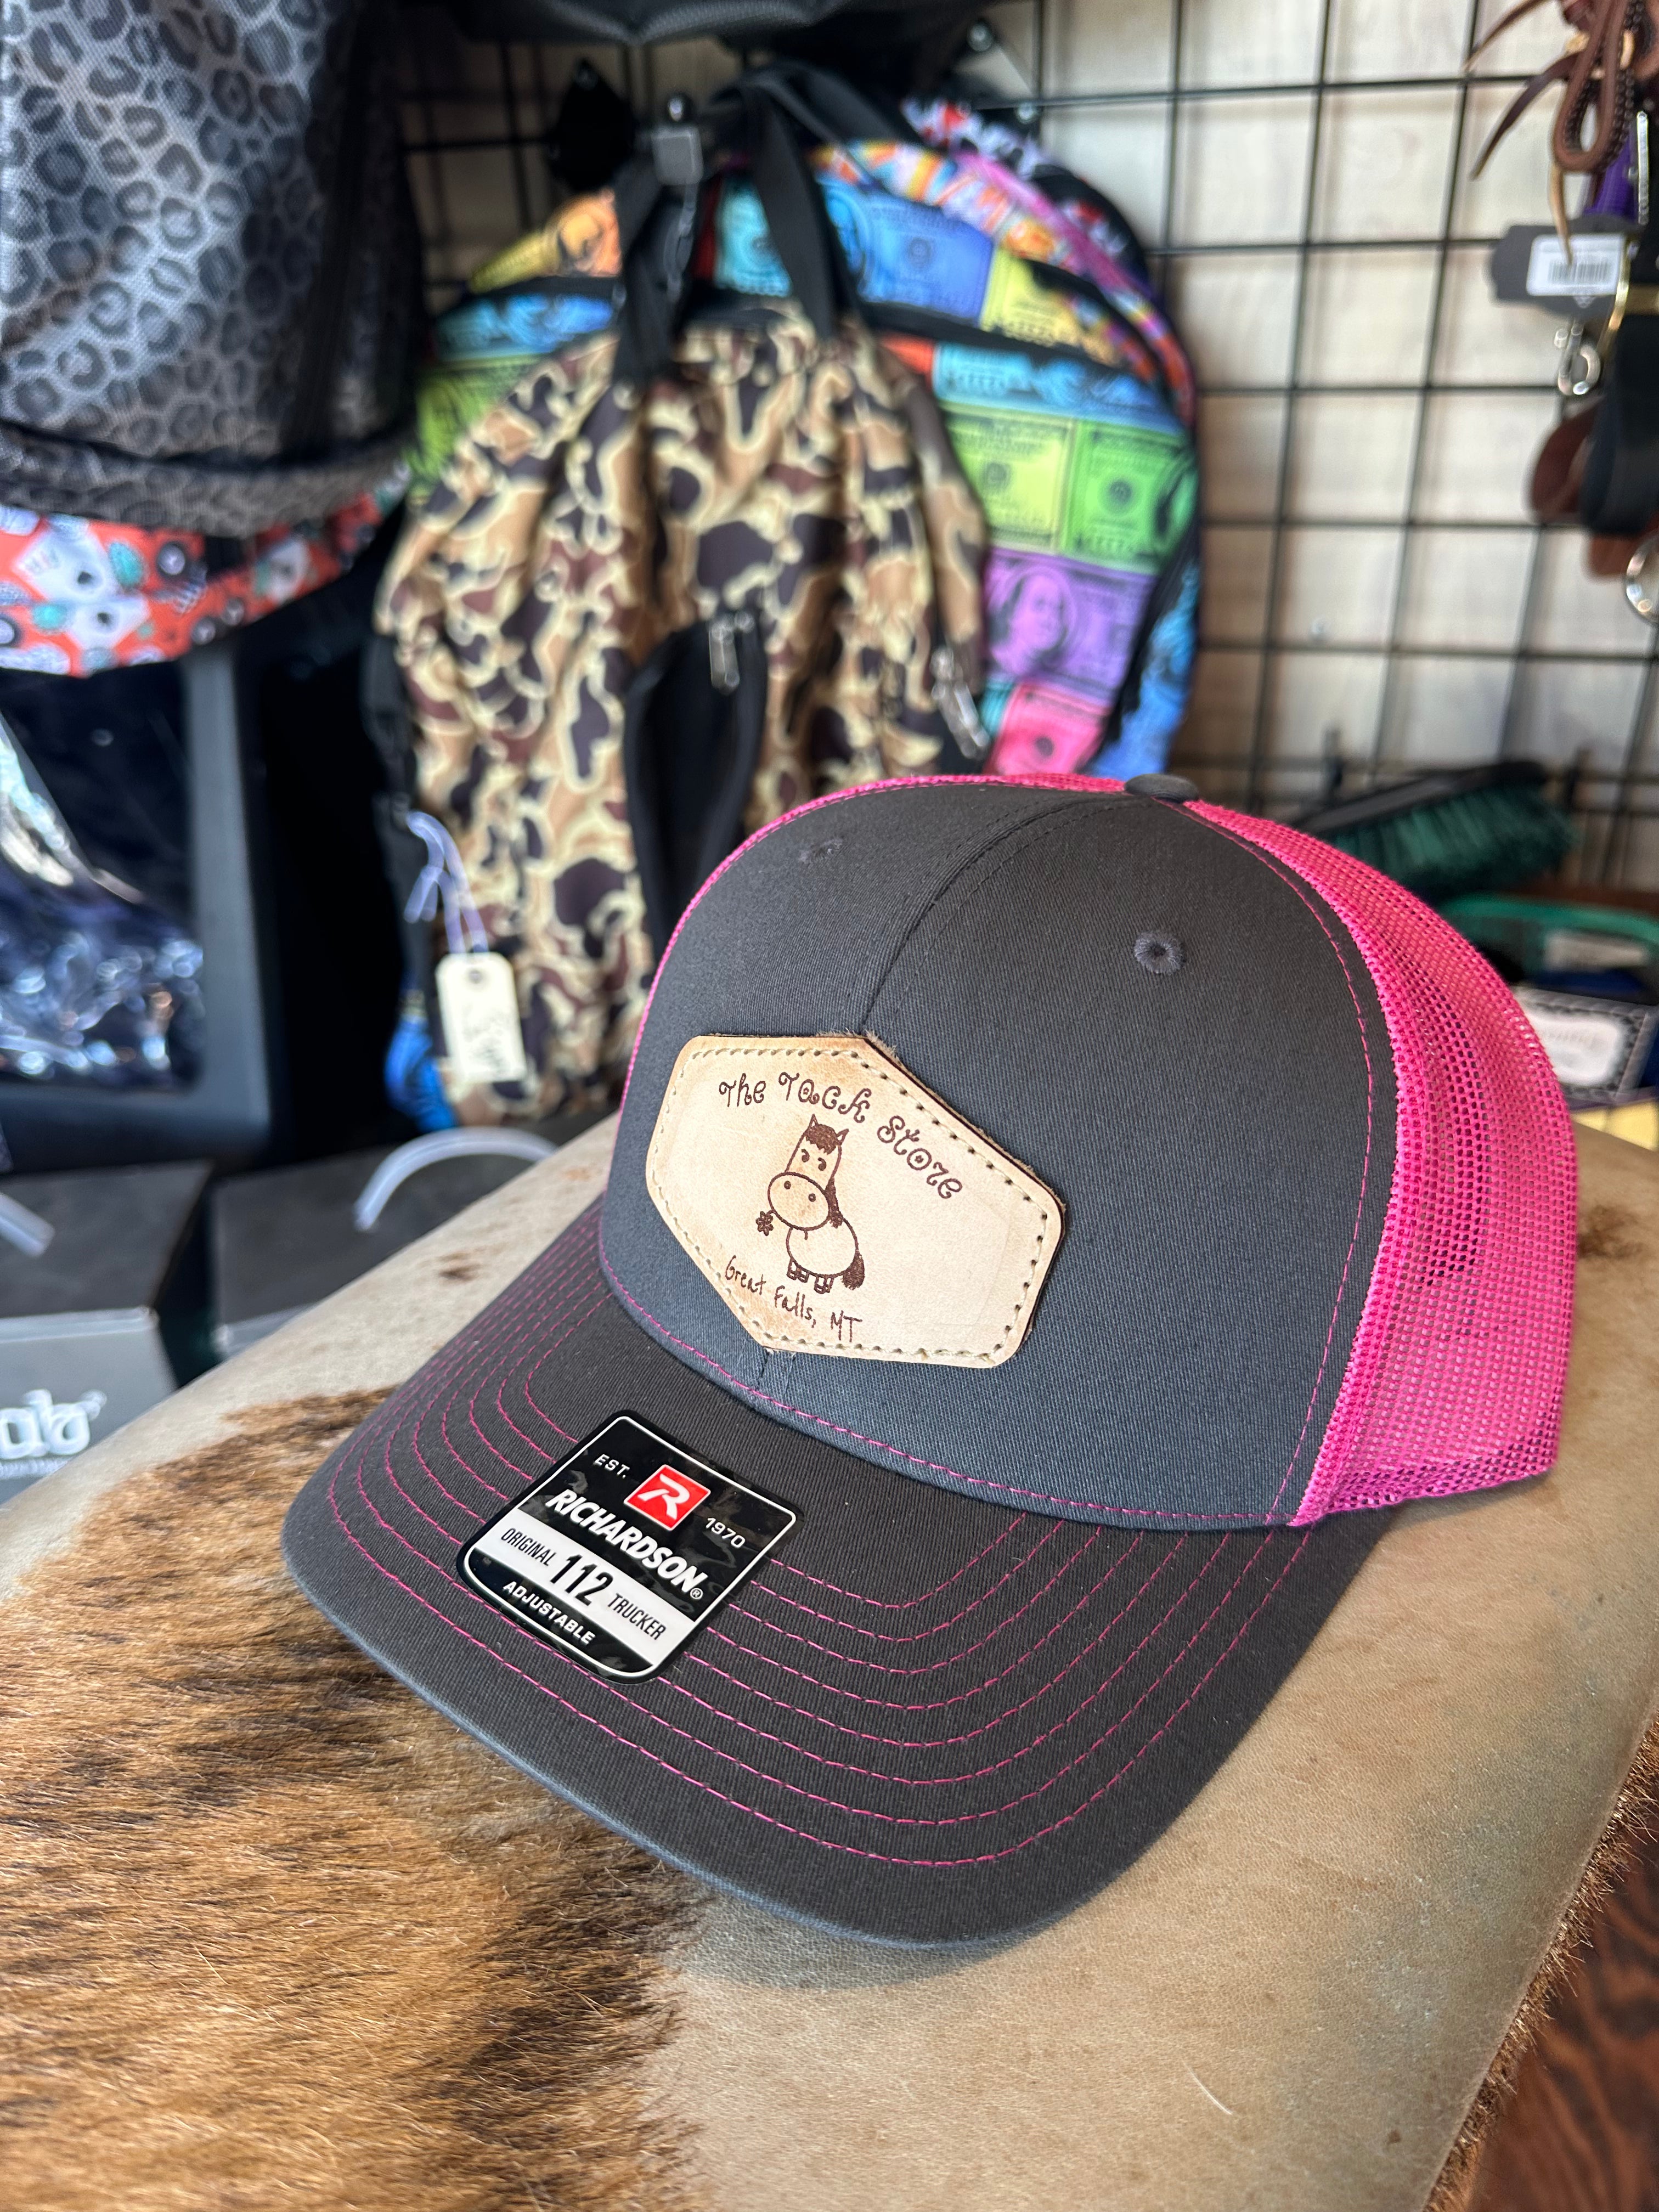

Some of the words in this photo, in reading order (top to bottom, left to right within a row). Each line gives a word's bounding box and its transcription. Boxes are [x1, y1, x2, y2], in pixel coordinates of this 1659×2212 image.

[719, 1073, 766, 1107] The
[778, 1072, 871, 1123] Tack
[877, 1115, 962, 1199] Store
[725, 1255, 767, 1295] Great
[774, 1285, 816, 1328] Falls,
[831, 1311, 862, 1342] MT
[594, 1454, 631, 1479] EST.
[706, 1517, 746, 1548] 1970
[501, 1528, 557, 1566] ORIGINAL
[549, 1553, 614, 1606] 112
[607, 1592, 667, 1640] TRUCKER
[503, 1581, 596, 1645] ADJUSTABLE
